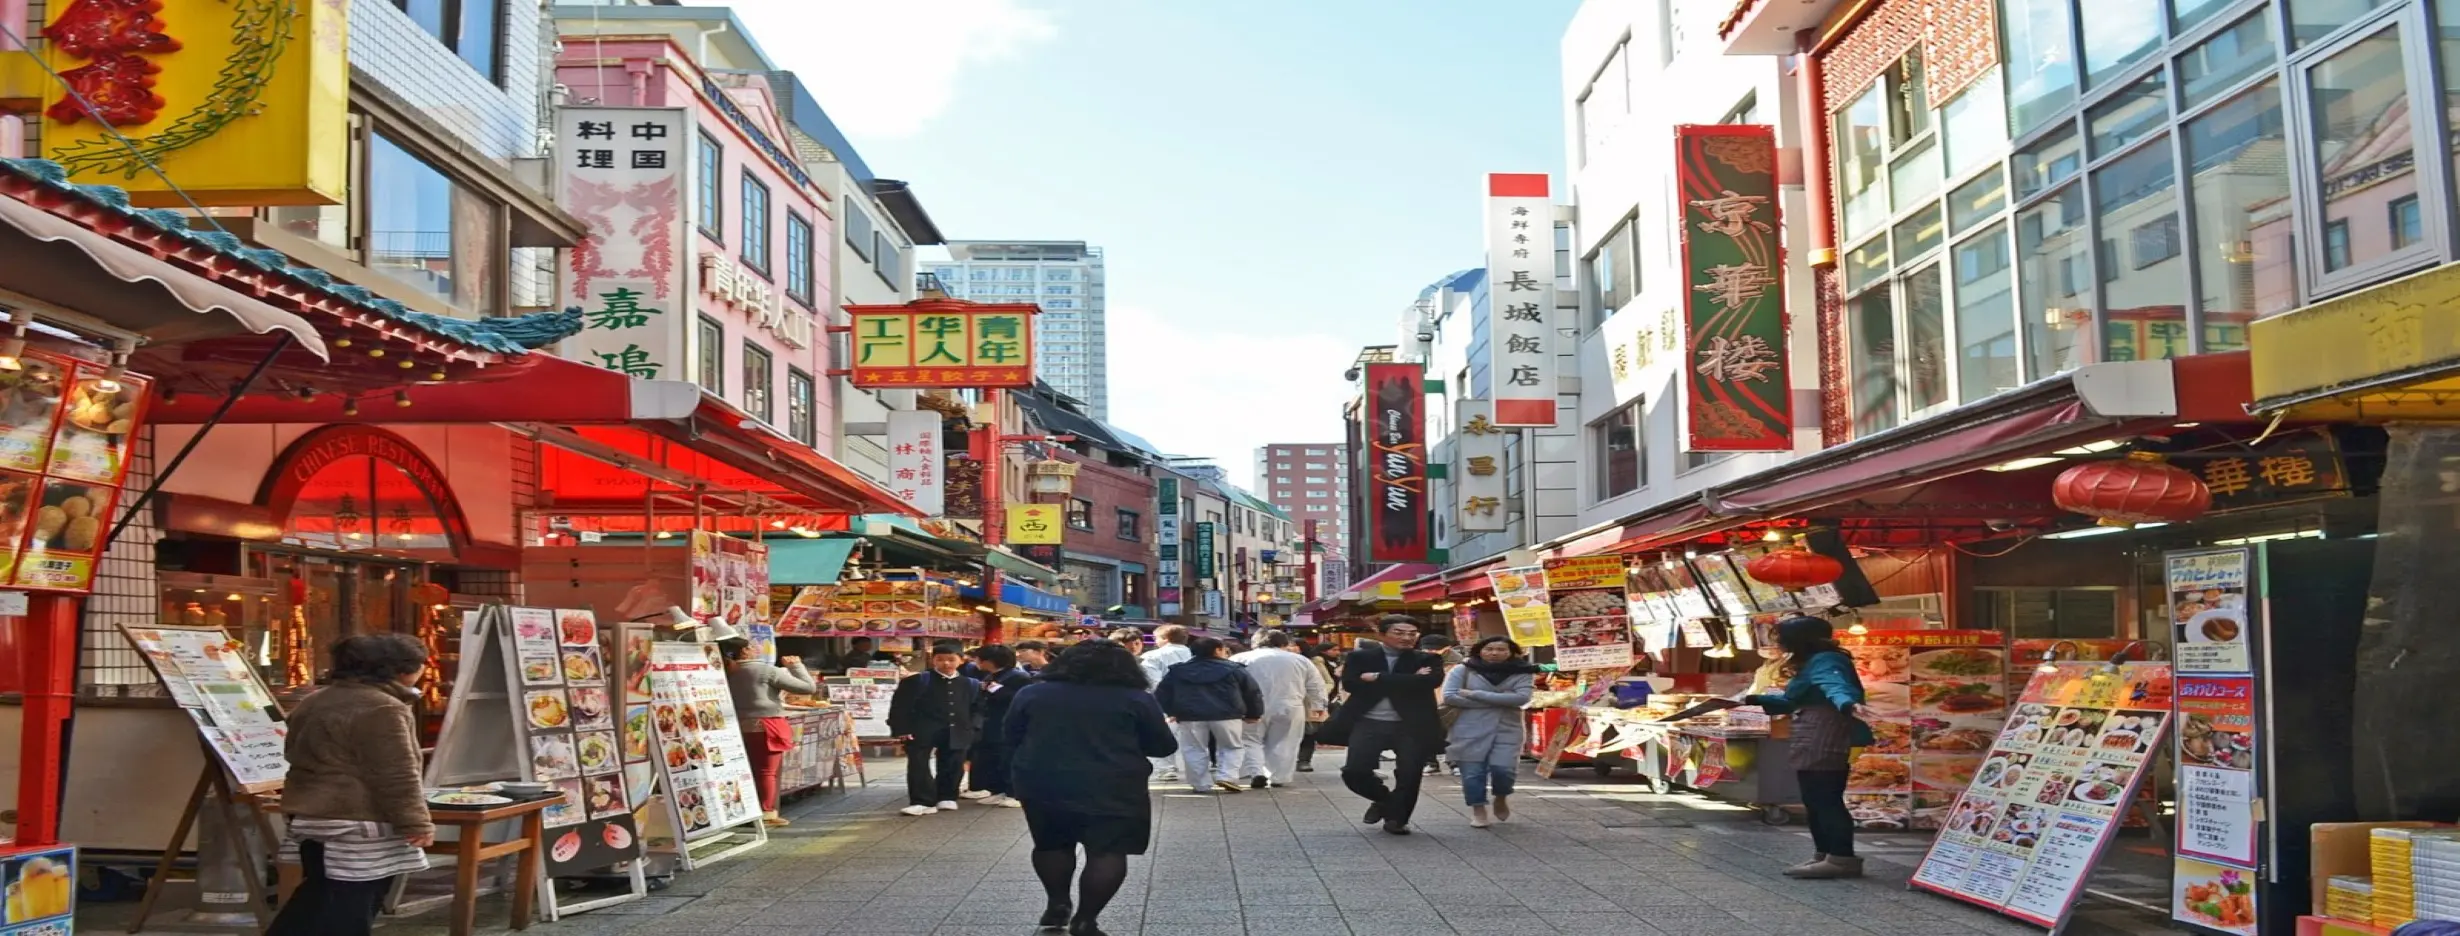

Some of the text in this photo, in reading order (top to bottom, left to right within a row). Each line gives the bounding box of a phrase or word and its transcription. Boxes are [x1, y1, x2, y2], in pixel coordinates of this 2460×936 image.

[1504, 270, 1544, 387] 長城飯店
[295, 435, 358, 482] CHINESE
[895, 443, 917, 500] 林商店
[1462, 414, 1502, 516] 永昌行
[2180, 683, 2246, 697] あわびコース
